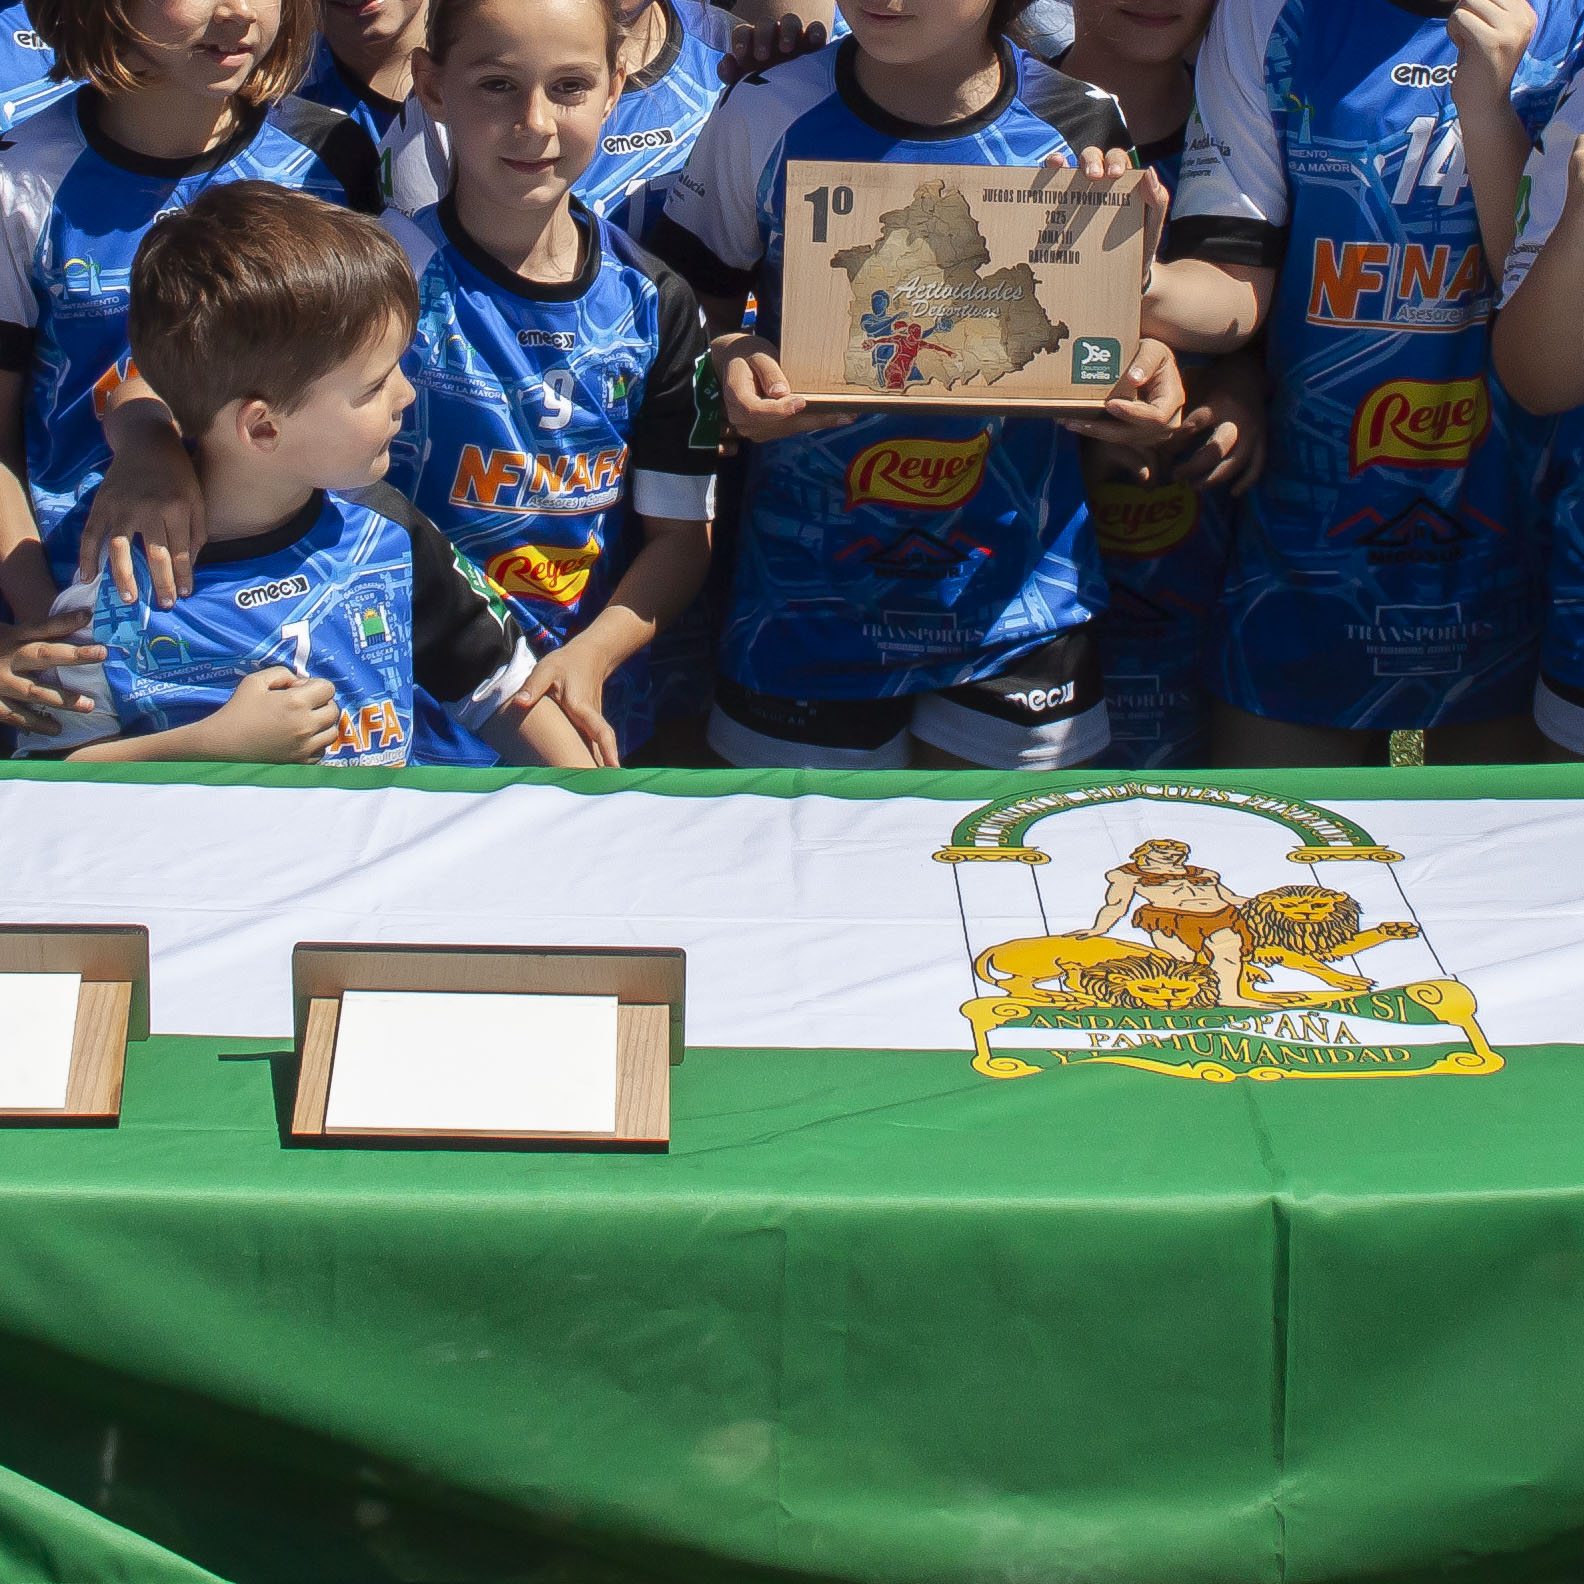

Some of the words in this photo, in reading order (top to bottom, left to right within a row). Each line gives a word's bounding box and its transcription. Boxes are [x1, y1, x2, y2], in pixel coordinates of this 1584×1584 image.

[603, 132, 659, 154] emec
[1308, 162, 1351, 174] MAYOR
[1390, 115, 1469, 206] 14
[983, 189, 1014, 203] JUEGOS
[1016, 190, 1067, 205] DEPORTIVOS
[1071, 192, 1131, 207] PROVINCIALES
[1045, 210, 1066, 224] 2025
[1308, 238, 1391, 320] NF
[1398, 243, 1486, 301] NA
[892, 276, 1025, 302] Actividades
[911, 300, 1001, 322] Deportivas
[517, 329, 564, 349] emec
[469, 386, 502, 400] MAYOR
[537, 369, 575, 430] 9
[1368, 392, 1475, 450] Reye
[452, 444, 525, 504] NF
[858, 448, 977, 499] Reyes
[528, 494, 577, 509] Asesores
[1097, 494, 1185, 534] eyes
[495, 554, 589, 592] Reyes
[237, 577, 293, 606] emec
[281, 618, 312, 679] 7
[329, 701, 404, 752] AFA
[1084, 781, 1236, 804] HERCULES
[1370, 993, 1409, 1024] SI
[1087, 1032, 1165, 1049] PAR
